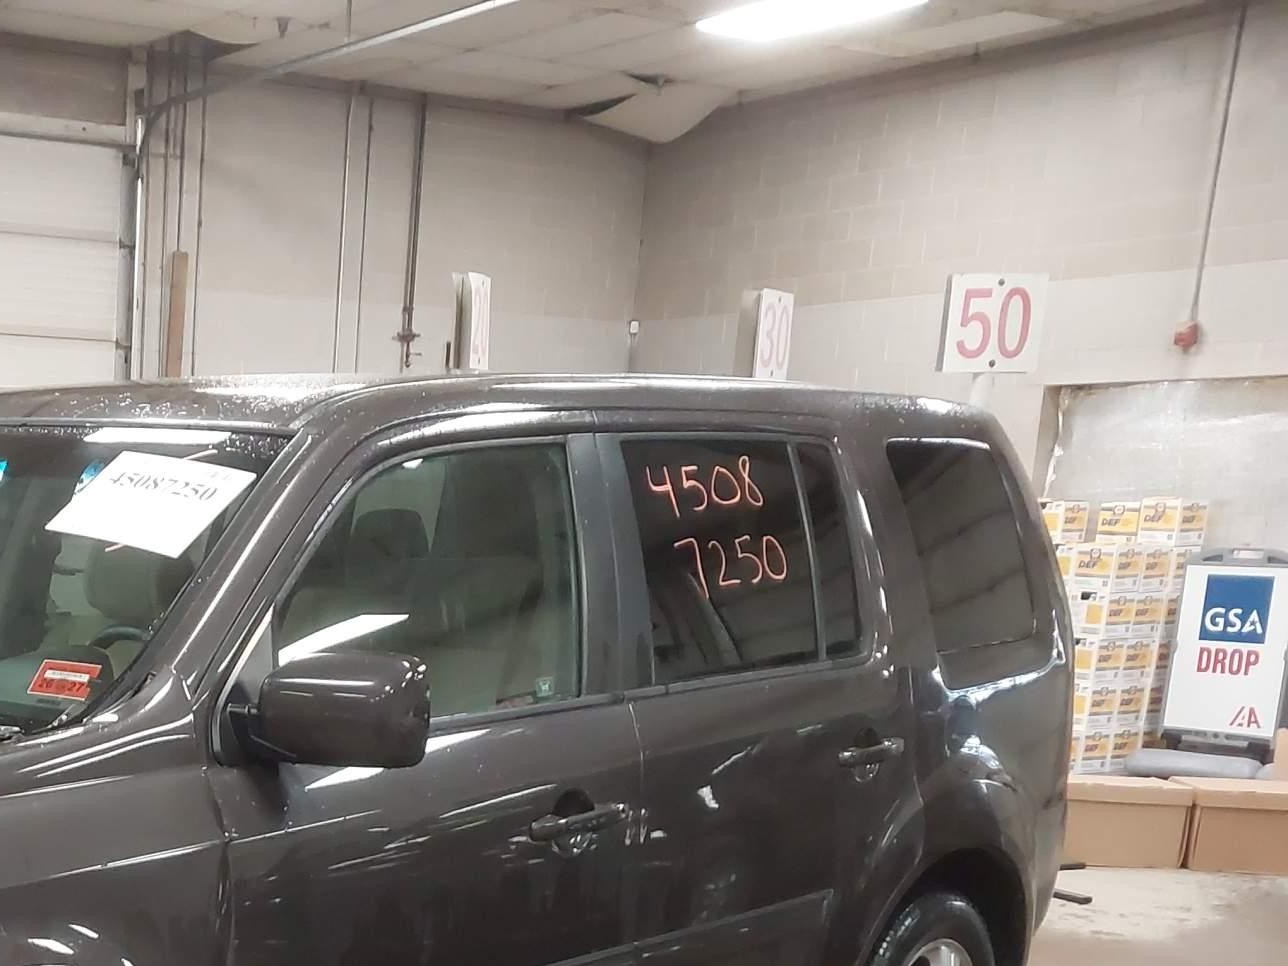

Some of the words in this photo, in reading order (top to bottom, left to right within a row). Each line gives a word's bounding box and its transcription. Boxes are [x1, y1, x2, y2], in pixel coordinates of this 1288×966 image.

[760, 303, 790, 370] 30
[956, 287, 1032, 359] 50
[110, 471, 219, 501] 45087250
[646, 455, 763, 518] 4508
[673, 535, 787, 600] 7250
[1204, 607, 1263, 634] GSA
[1196, 646, 1260, 676] DROP
